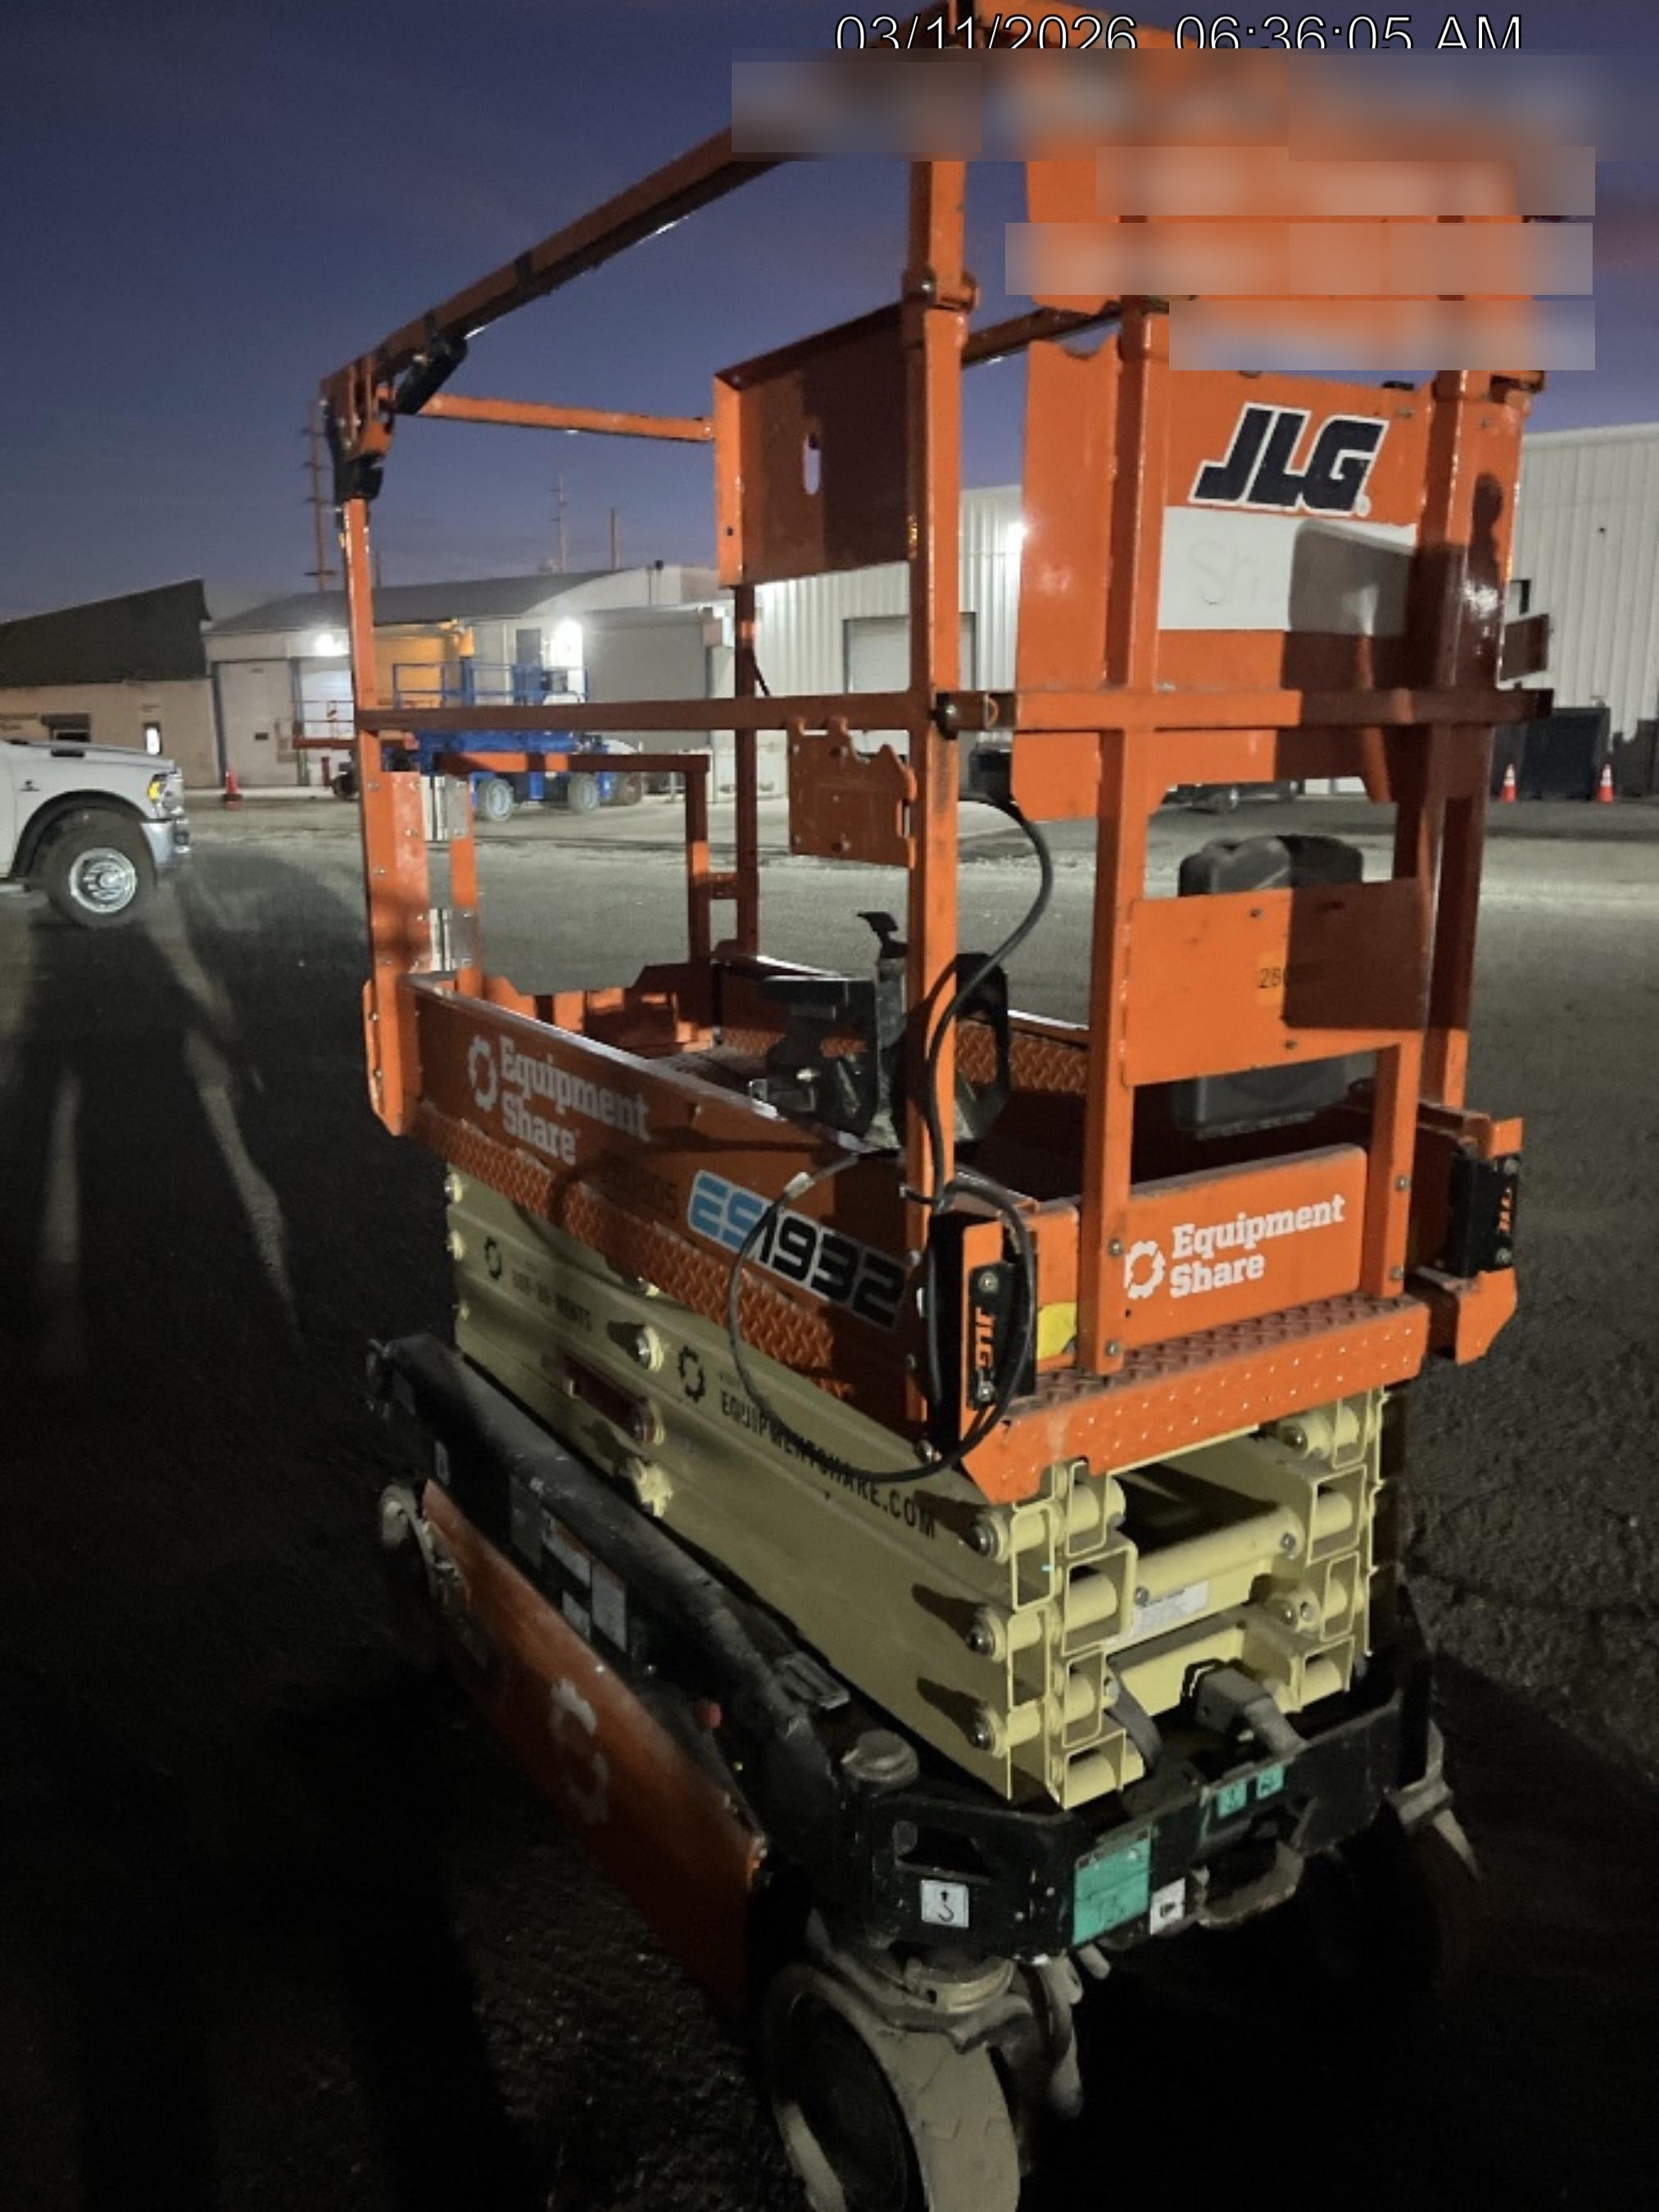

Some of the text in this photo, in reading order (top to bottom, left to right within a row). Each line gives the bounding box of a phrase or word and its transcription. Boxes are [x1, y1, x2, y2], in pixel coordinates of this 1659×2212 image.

[499, 1034, 652, 1142] Equipment
[501, 1090, 578, 1167] Share
[687, 1169, 906, 1334] ES1932
[1172, 1193, 1346, 1259] Equipment
[1168, 1253, 1266, 1299] Share
[974, 1305, 995, 1371] JLG
